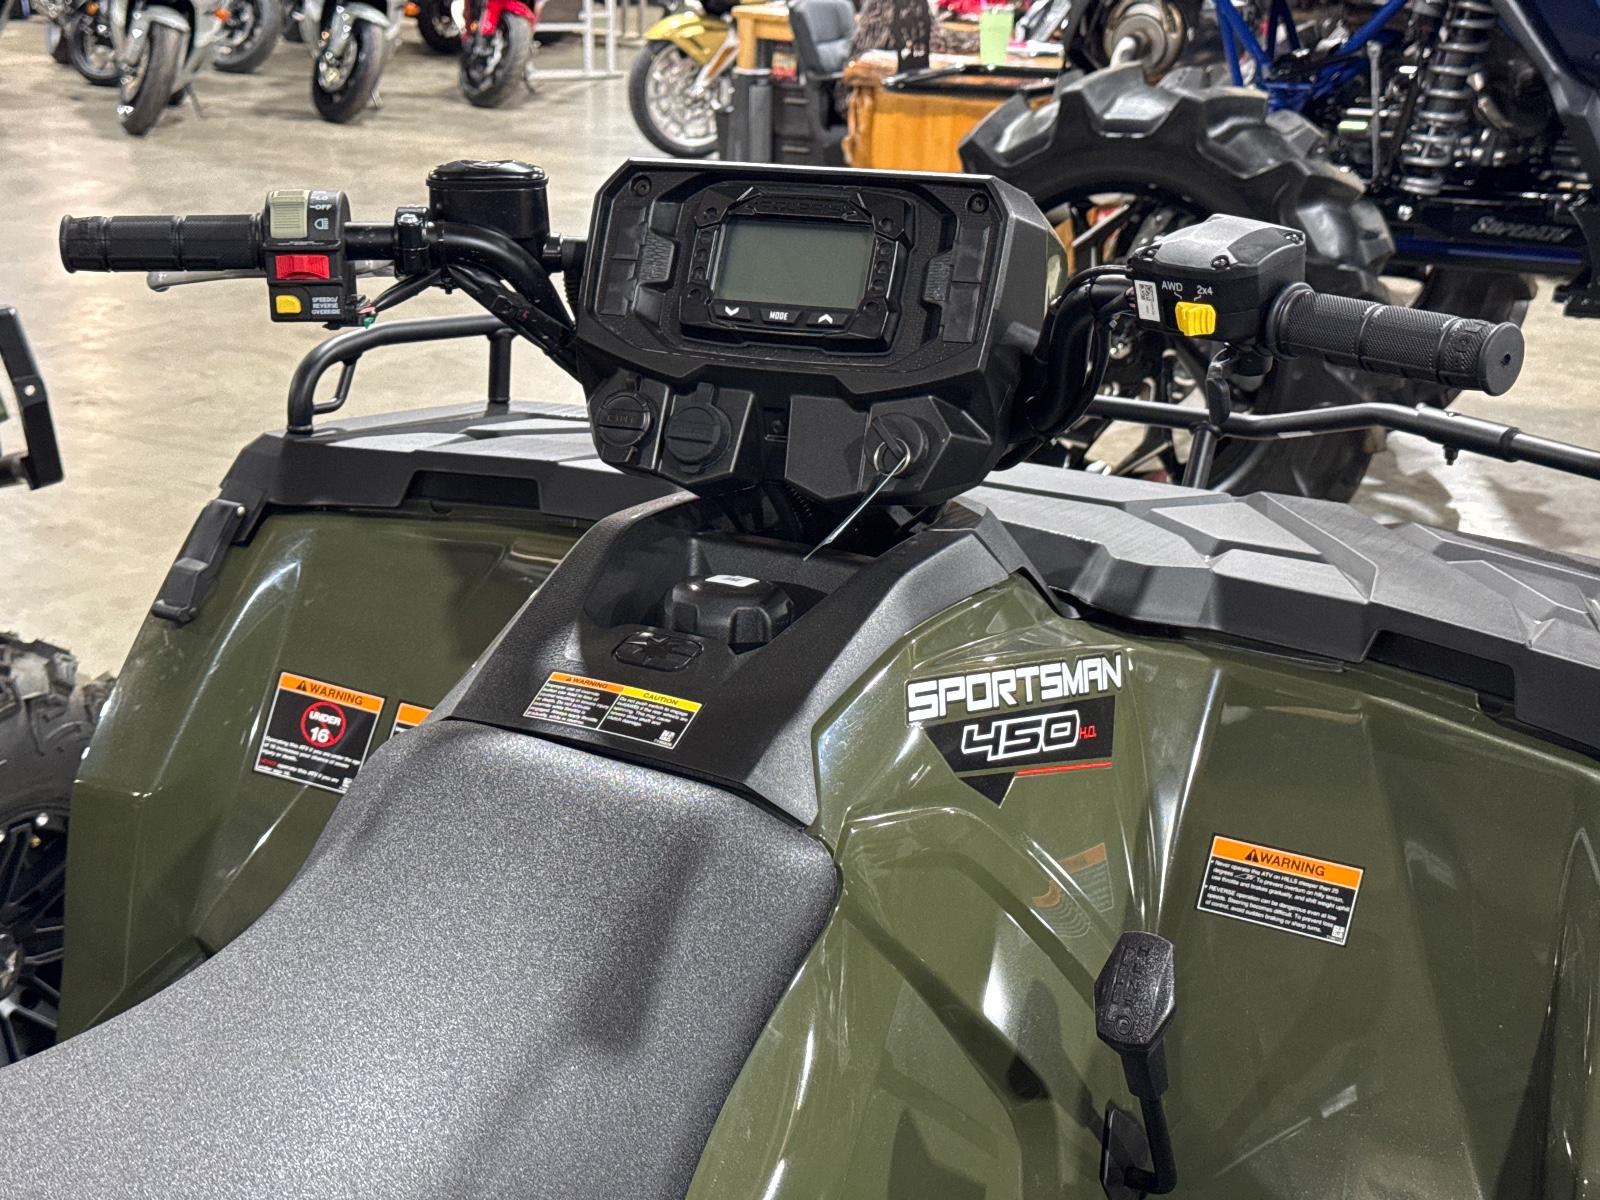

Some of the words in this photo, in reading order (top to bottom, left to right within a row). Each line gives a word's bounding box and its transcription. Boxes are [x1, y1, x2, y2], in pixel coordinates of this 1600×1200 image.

[1162, 280, 1183, 292] AWD
[1196, 284, 1213, 296] 2x4
[770, 310, 788, 320] MODE
[573, 678, 608, 688] WARNING
[907, 655, 1122, 722] SPORTSMAN
[310, 684, 362, 705] WARNING
[643, 693, 678, 704] CAUTION
[309, 711, 341, 725] UNDER
[311, 727, 329, 743] 16
[961, 709, 1080, 762] 450
[1080, 725, 1096, 739] H.O.
[1261, 853, 1324, 876] WARNING
[1213, 868, 1233, 876] degrees
[1284, 885, 1305, 893] overturn
[1222, 877, 1239, 885] throttle
[1250, 884, 1268, 892] brakes
[1209, 885, 1235, 895] REVERSE
[1236, 893, 1260, 901] operation
[1279, 903, 1306, 913] dangerous
[1227, 897, 1248, 907] Steering
[1249, 903, 1272, 912] becomes
[1302, 916, 1322, 924] prevent
[1265, 914, 1284, 924] braking
